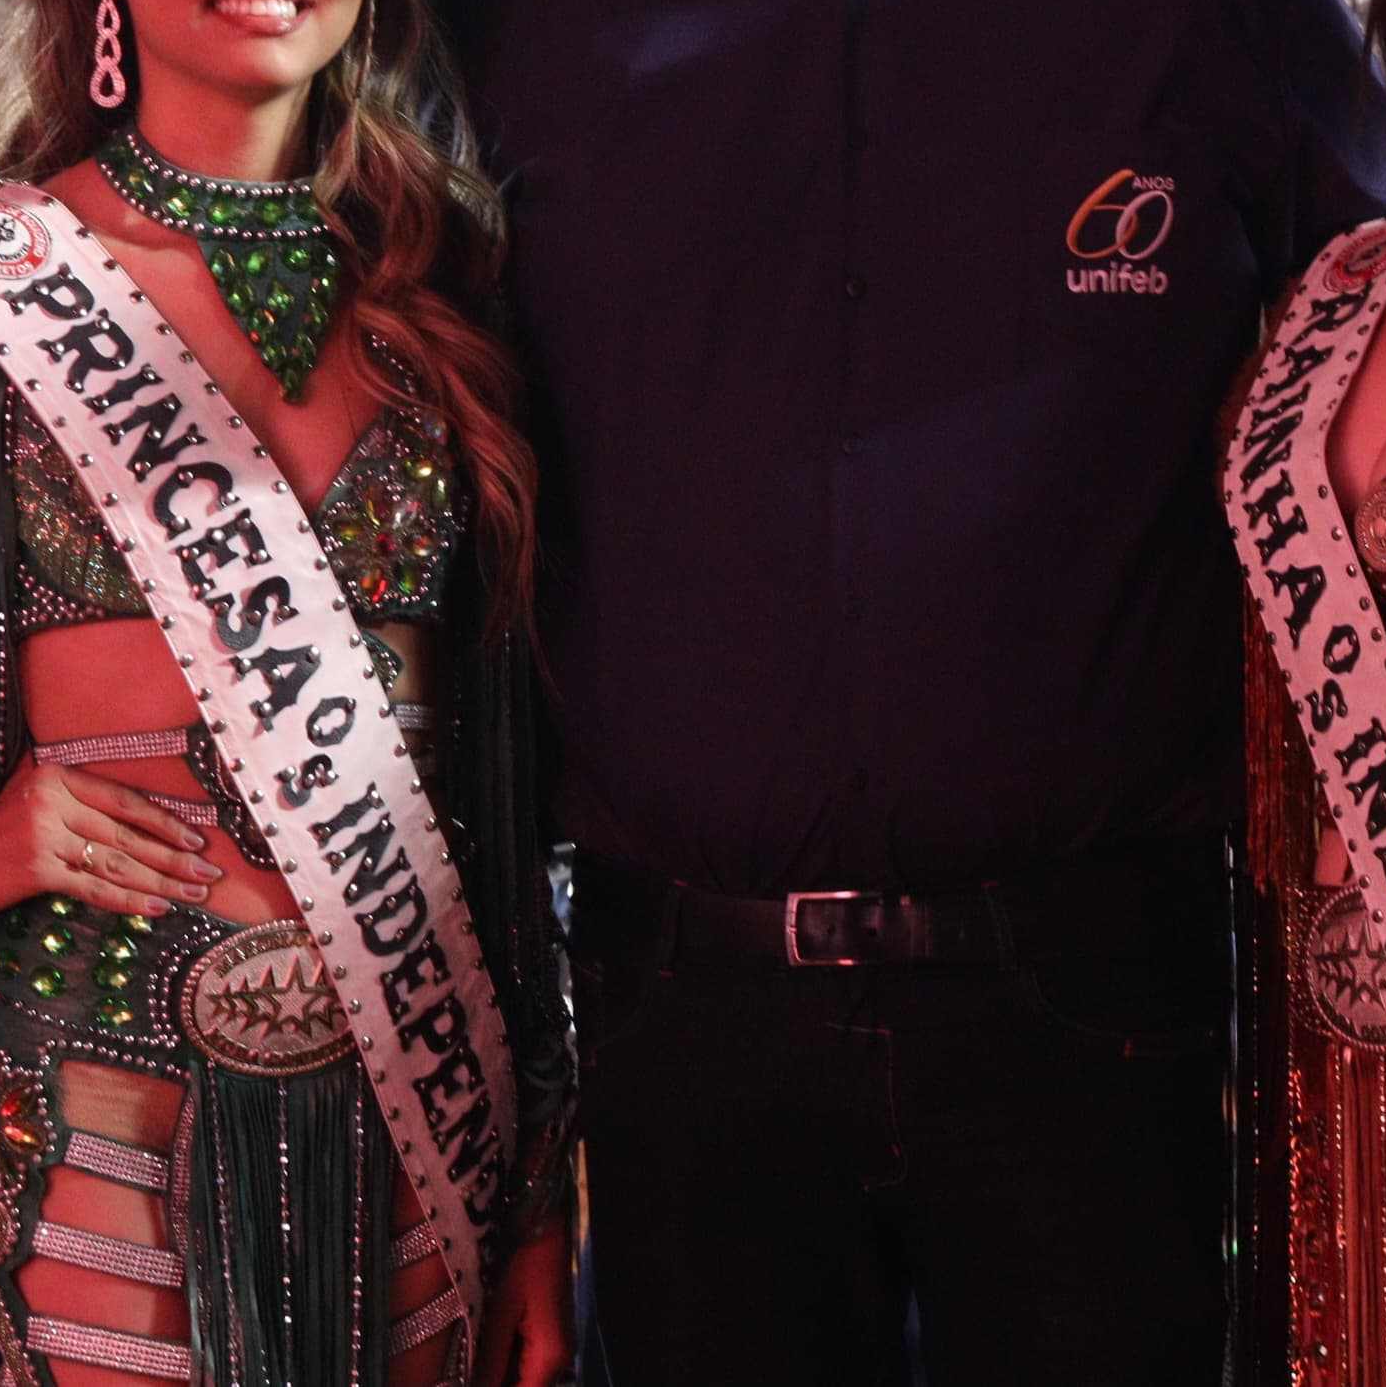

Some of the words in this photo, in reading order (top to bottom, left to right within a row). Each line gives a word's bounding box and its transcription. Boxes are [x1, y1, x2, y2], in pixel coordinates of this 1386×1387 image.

[1065, 169, 1174, 260] 60
[1132, 176, 1175, 190] ANOS
[1066, 261, 1169, 295] unifeb
[0, 261, 322, 734] PRINCESA
[1239, 291, 1362, 648] RAINHA
